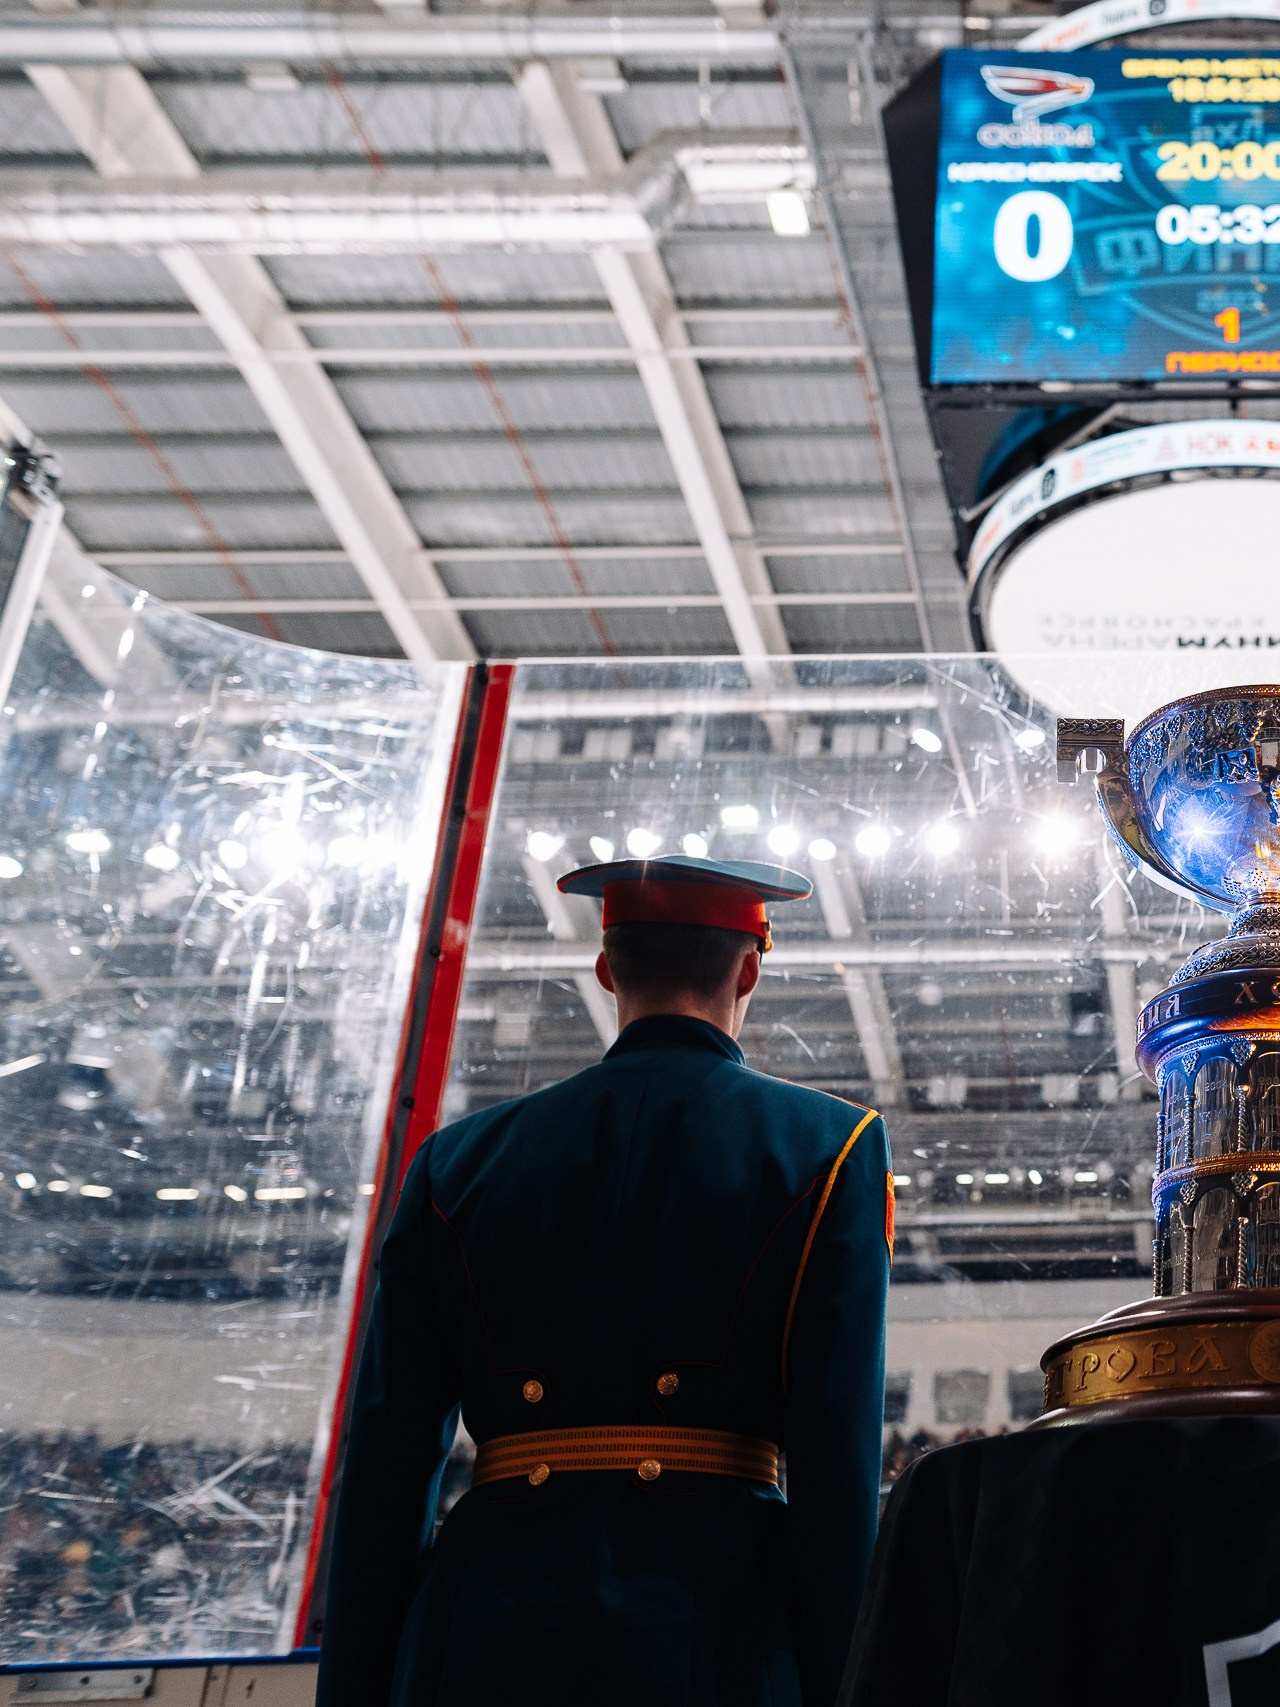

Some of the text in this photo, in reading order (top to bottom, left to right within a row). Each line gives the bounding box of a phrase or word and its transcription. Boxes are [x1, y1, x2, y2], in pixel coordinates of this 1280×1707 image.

[994, 190, 1073, 281] 0
[1214, 307, 1240, 343] 1
[1043, 1337, 1230, 1410] ТРОВА
